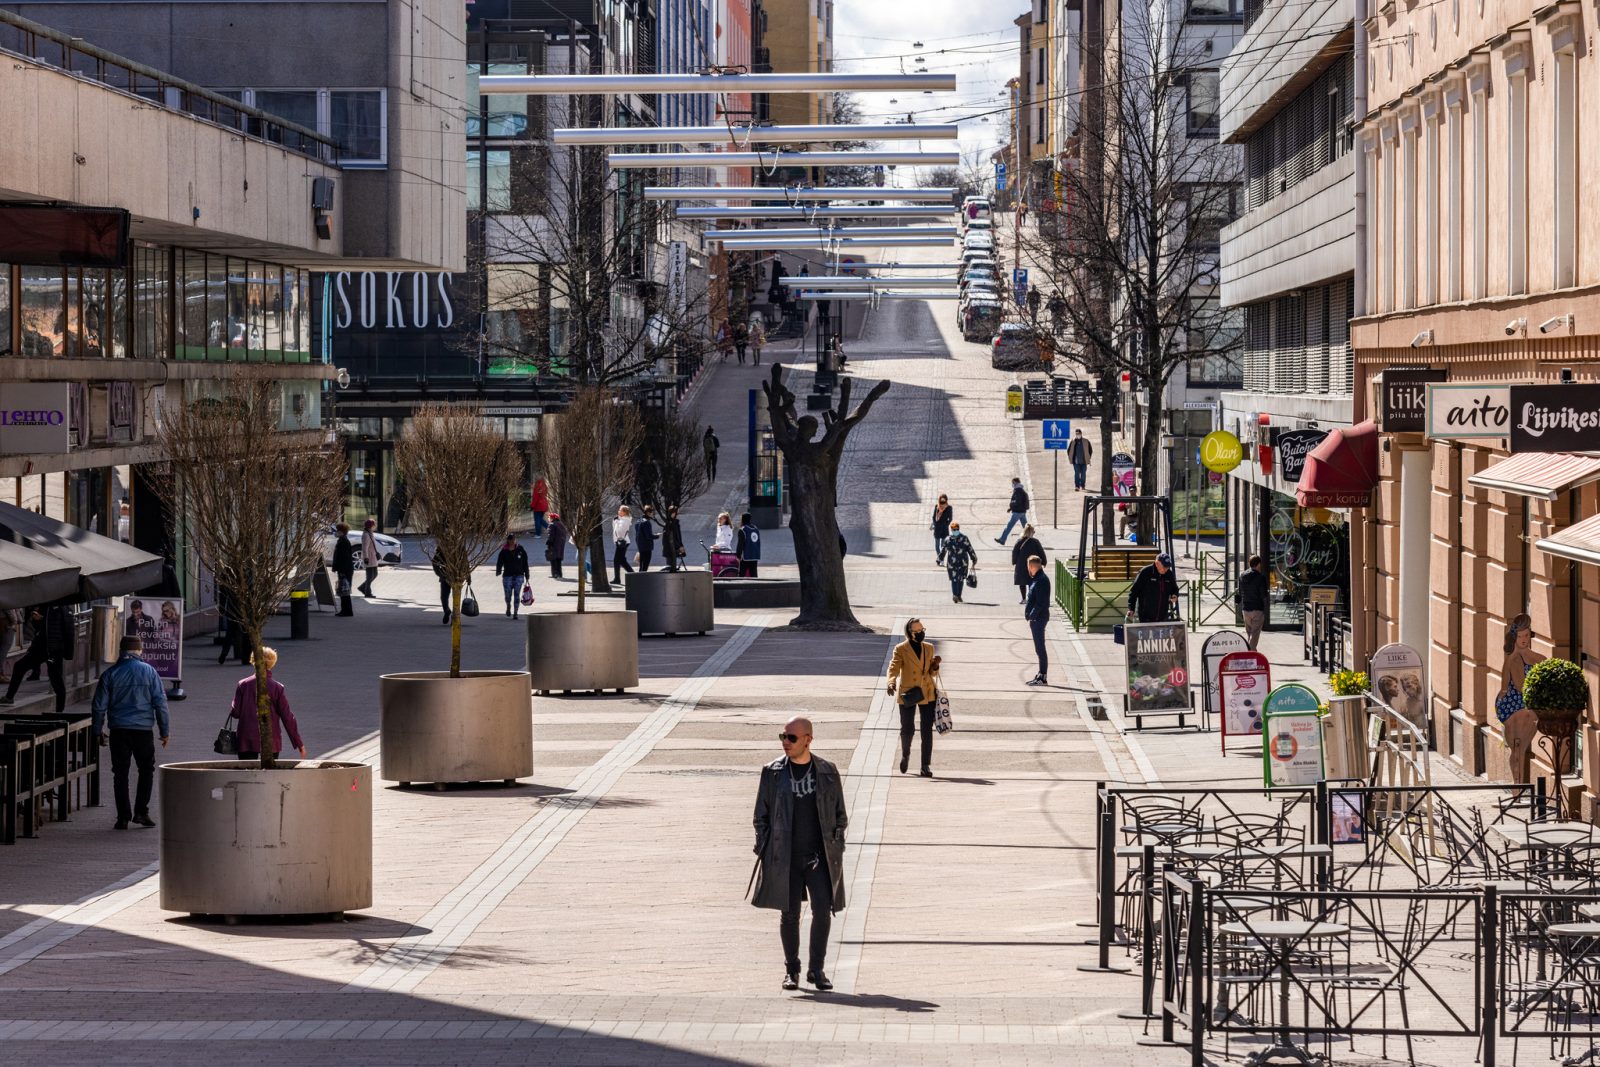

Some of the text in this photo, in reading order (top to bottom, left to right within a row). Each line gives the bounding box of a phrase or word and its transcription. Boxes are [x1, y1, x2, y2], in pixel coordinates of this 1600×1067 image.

[1016, 271, 1025, 281] P
[336, 271, 454, 328] SOKOS
[1389, 388, 1425, 409] liik
[1446, 394, 1509, 428] aito
[1205, 437, 1239, 463] Olavi
[1336, 493, 1369, 505] koruja
[138, 618, 169, 631] Paljon
[141, 640, 177, 649] tuuksia
[1137, 638, 1177, 653] ANNIKA
[141, 652, 176, 662] apunut
[1387, 654, 1408, 662] LIIKE
[1169, 670, 1185, 683] 10
